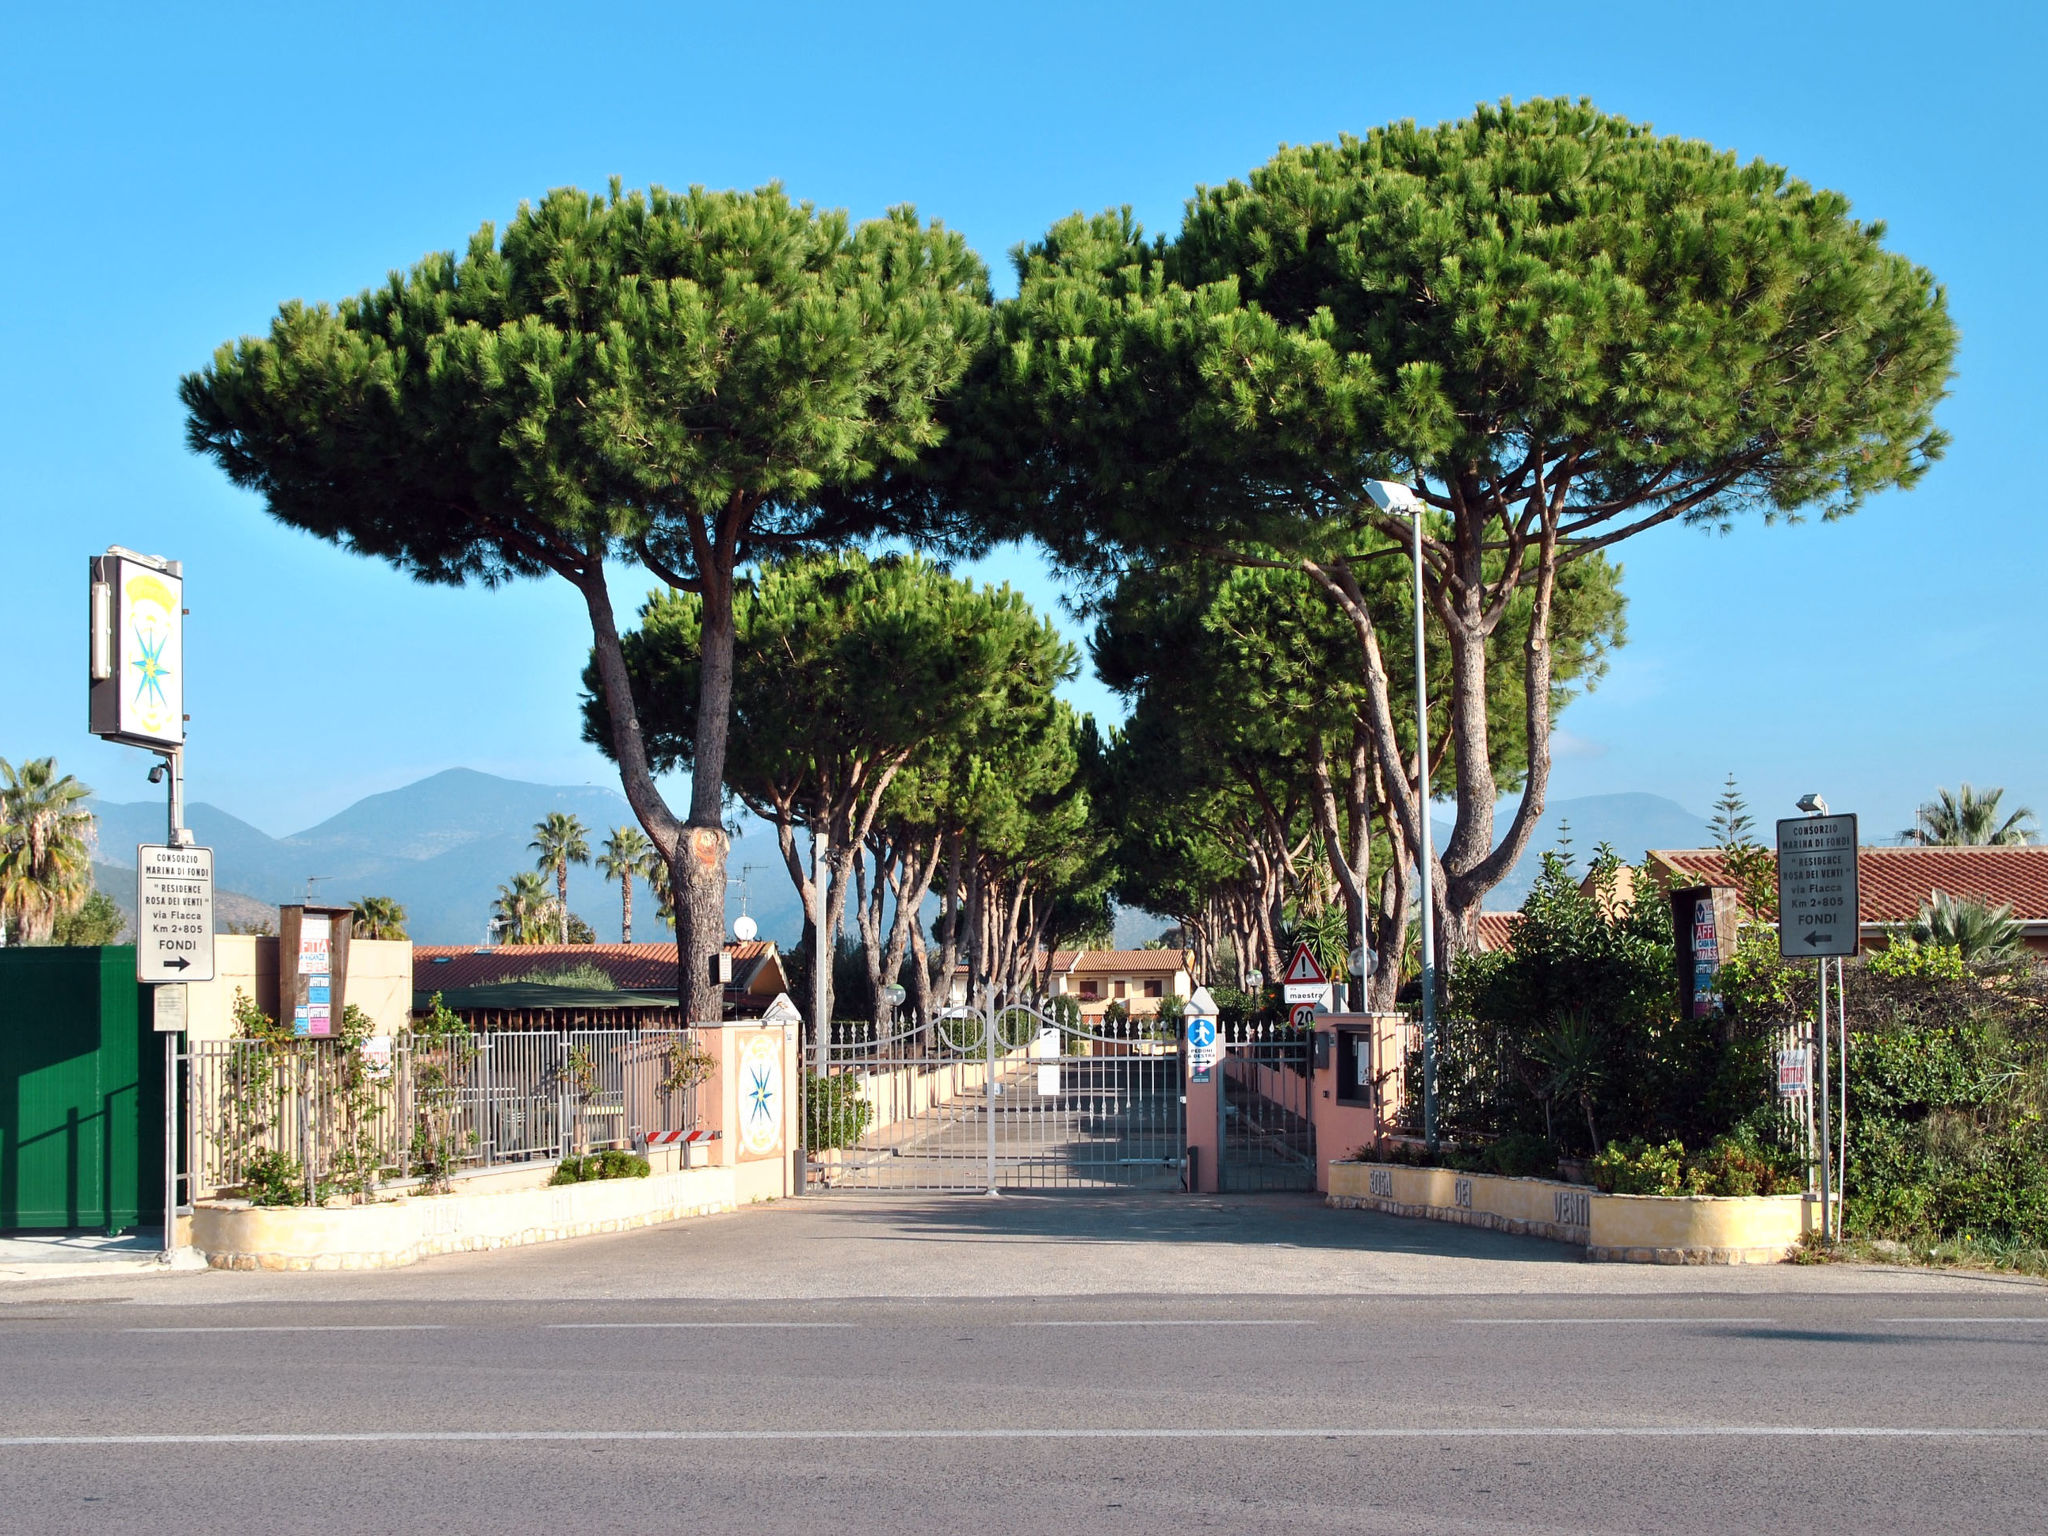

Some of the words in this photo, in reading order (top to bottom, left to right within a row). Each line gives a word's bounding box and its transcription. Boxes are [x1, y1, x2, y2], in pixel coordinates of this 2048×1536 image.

[1793, 824, 1838, 836] CONSORZIO
[1782, 839, 1813, 849] MARINA
[1815, 838, 1823, 847] DI
[1826, 835, 1850, 847] FONDI
[156, 853, 198, 864] CONSORZIO
[145, 865, 175, 875] MARINA
[177, 867, 185, 875] DI
[187, 868, 209, 877] FONDI
[1782, 871, 1804, 881] ROSA
[1805, 870, 1819, 880] DEI
[1791, 885, 1805, 894] via
[1809, 884, 1842, 893] Flacca
[145, 896, 166, 905] ROSA
[168, 897, 180, 906] DEI
[1791, 899, 1807, 909] Km
[153, 910, 167, 919] via
[171, 911, 202, 920] Flacca
[1798, 913, 1837, 926] FONDI
[152, 924, 168, 933] Km
[159, 940, 197, 951] FONDI
[1297, 1010, 1314, 1026] 20
